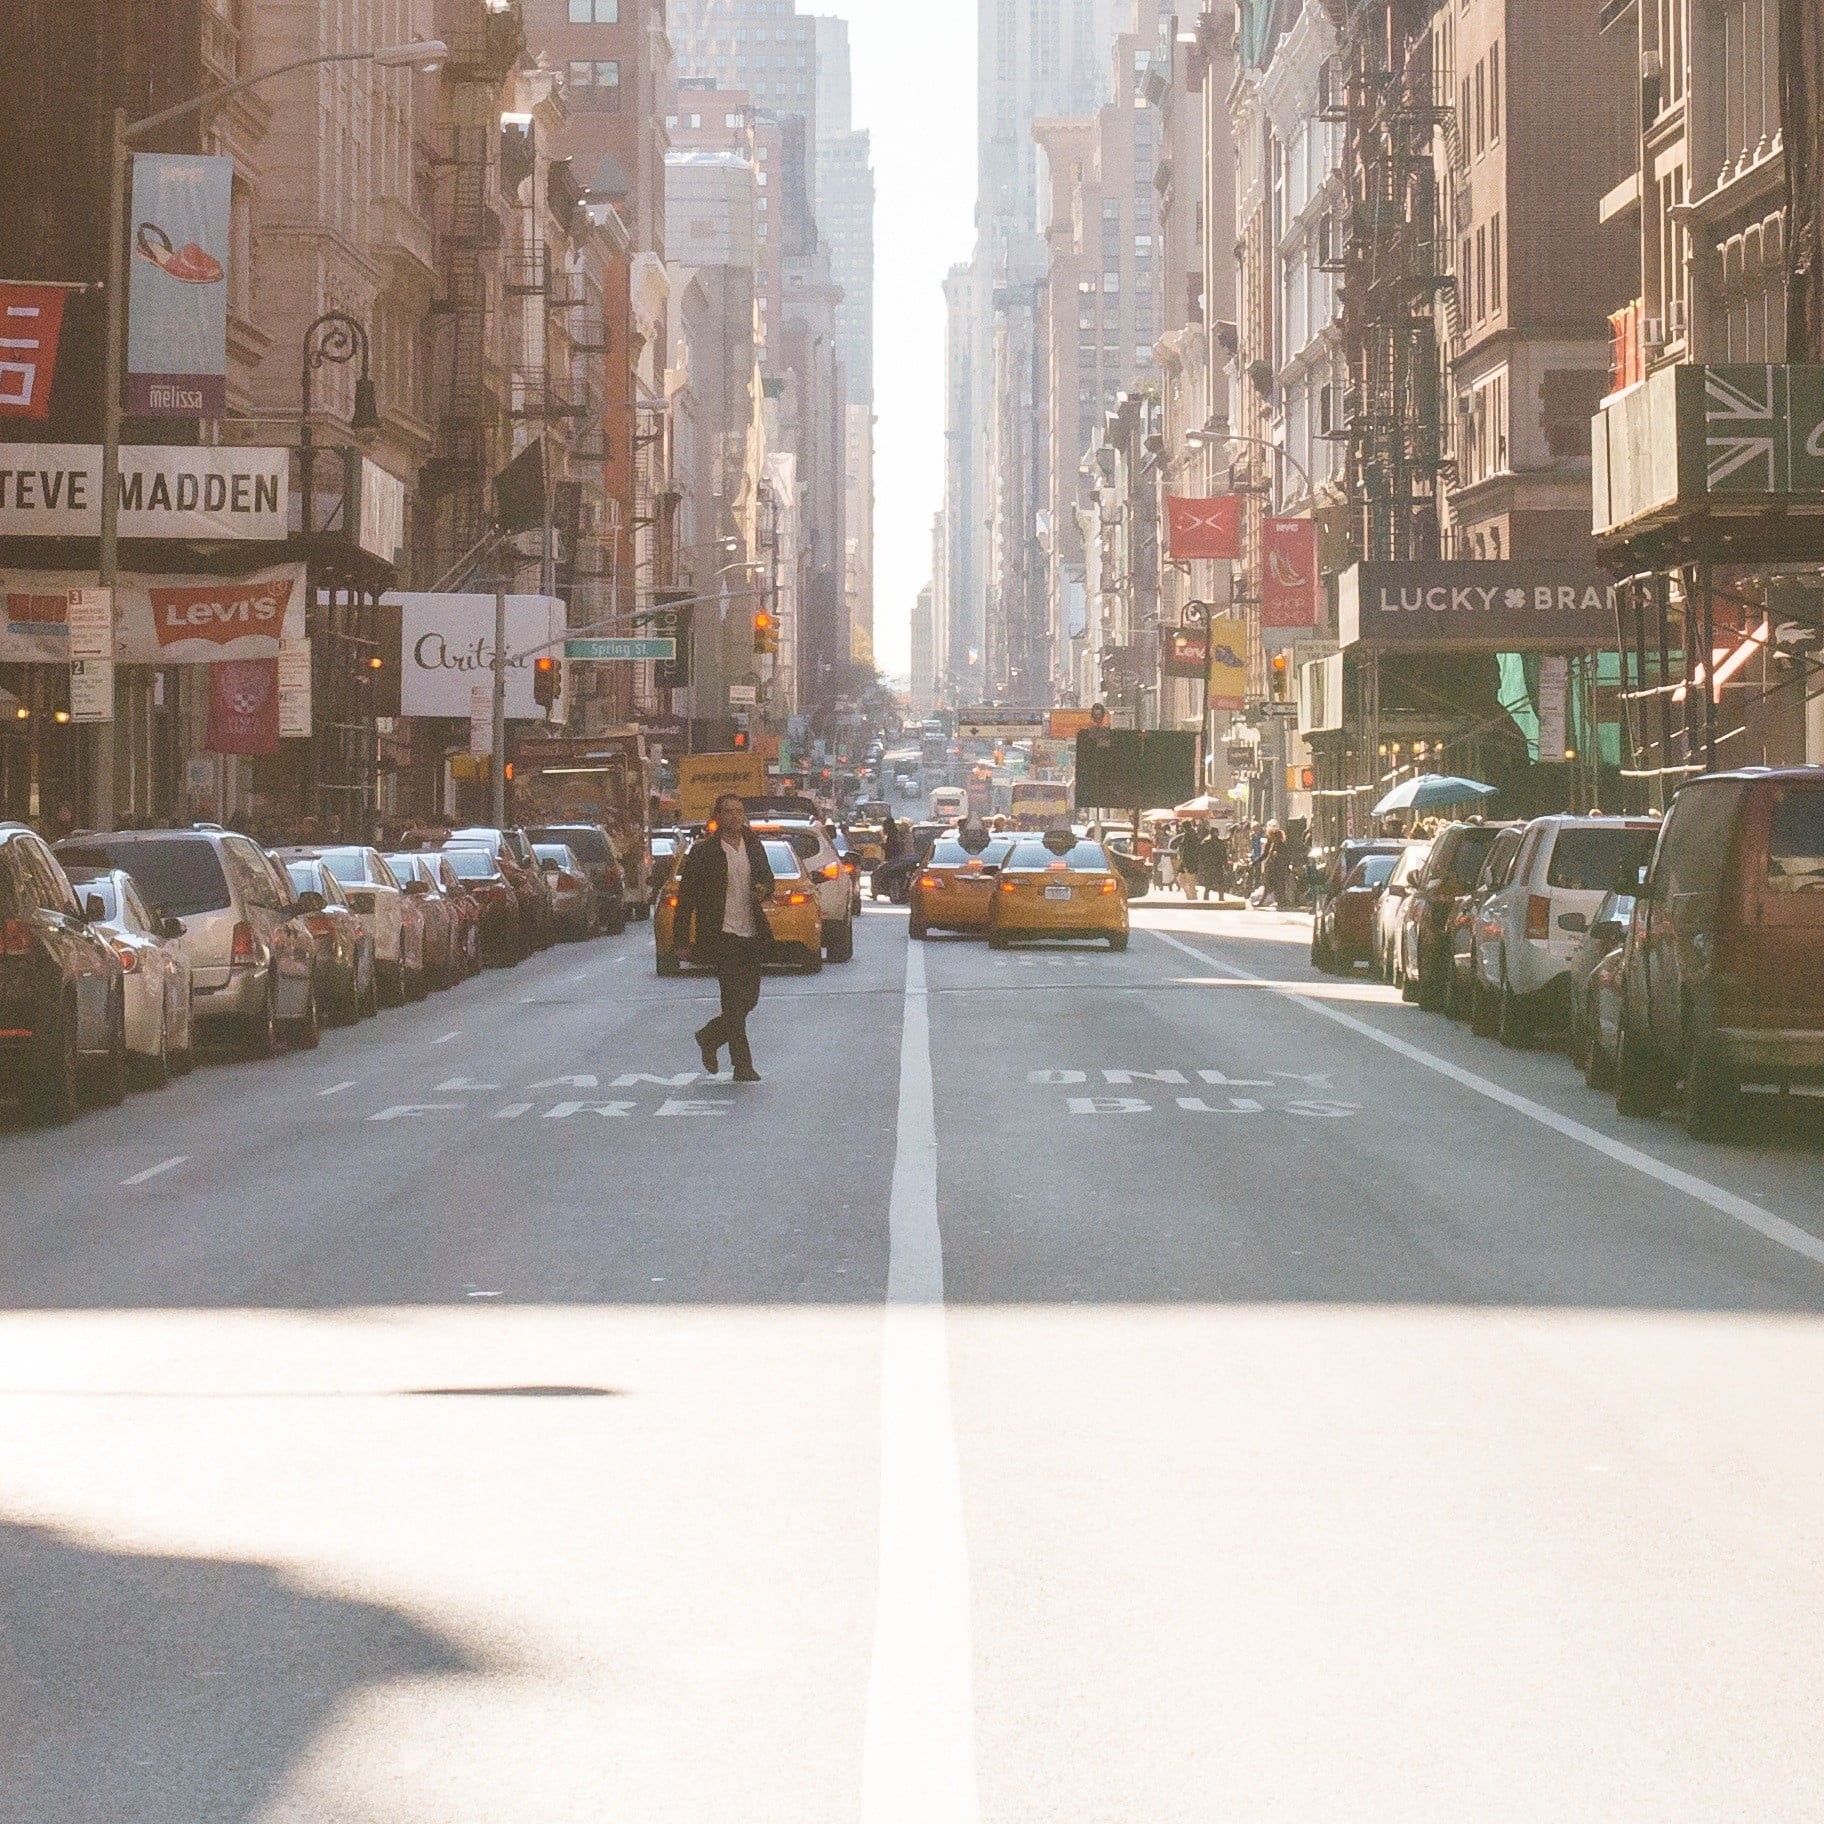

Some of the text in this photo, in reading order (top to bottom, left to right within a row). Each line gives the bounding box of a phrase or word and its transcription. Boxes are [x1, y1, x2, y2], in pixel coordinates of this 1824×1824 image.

[149, 385, 203, 410] melissa
[117, 471, 279, 514] MADDEN
[71, 591, 81, 604] 3
[1380, 586, 1499, 612] LUCKY
[590, 644, 647, 656] Spring St
